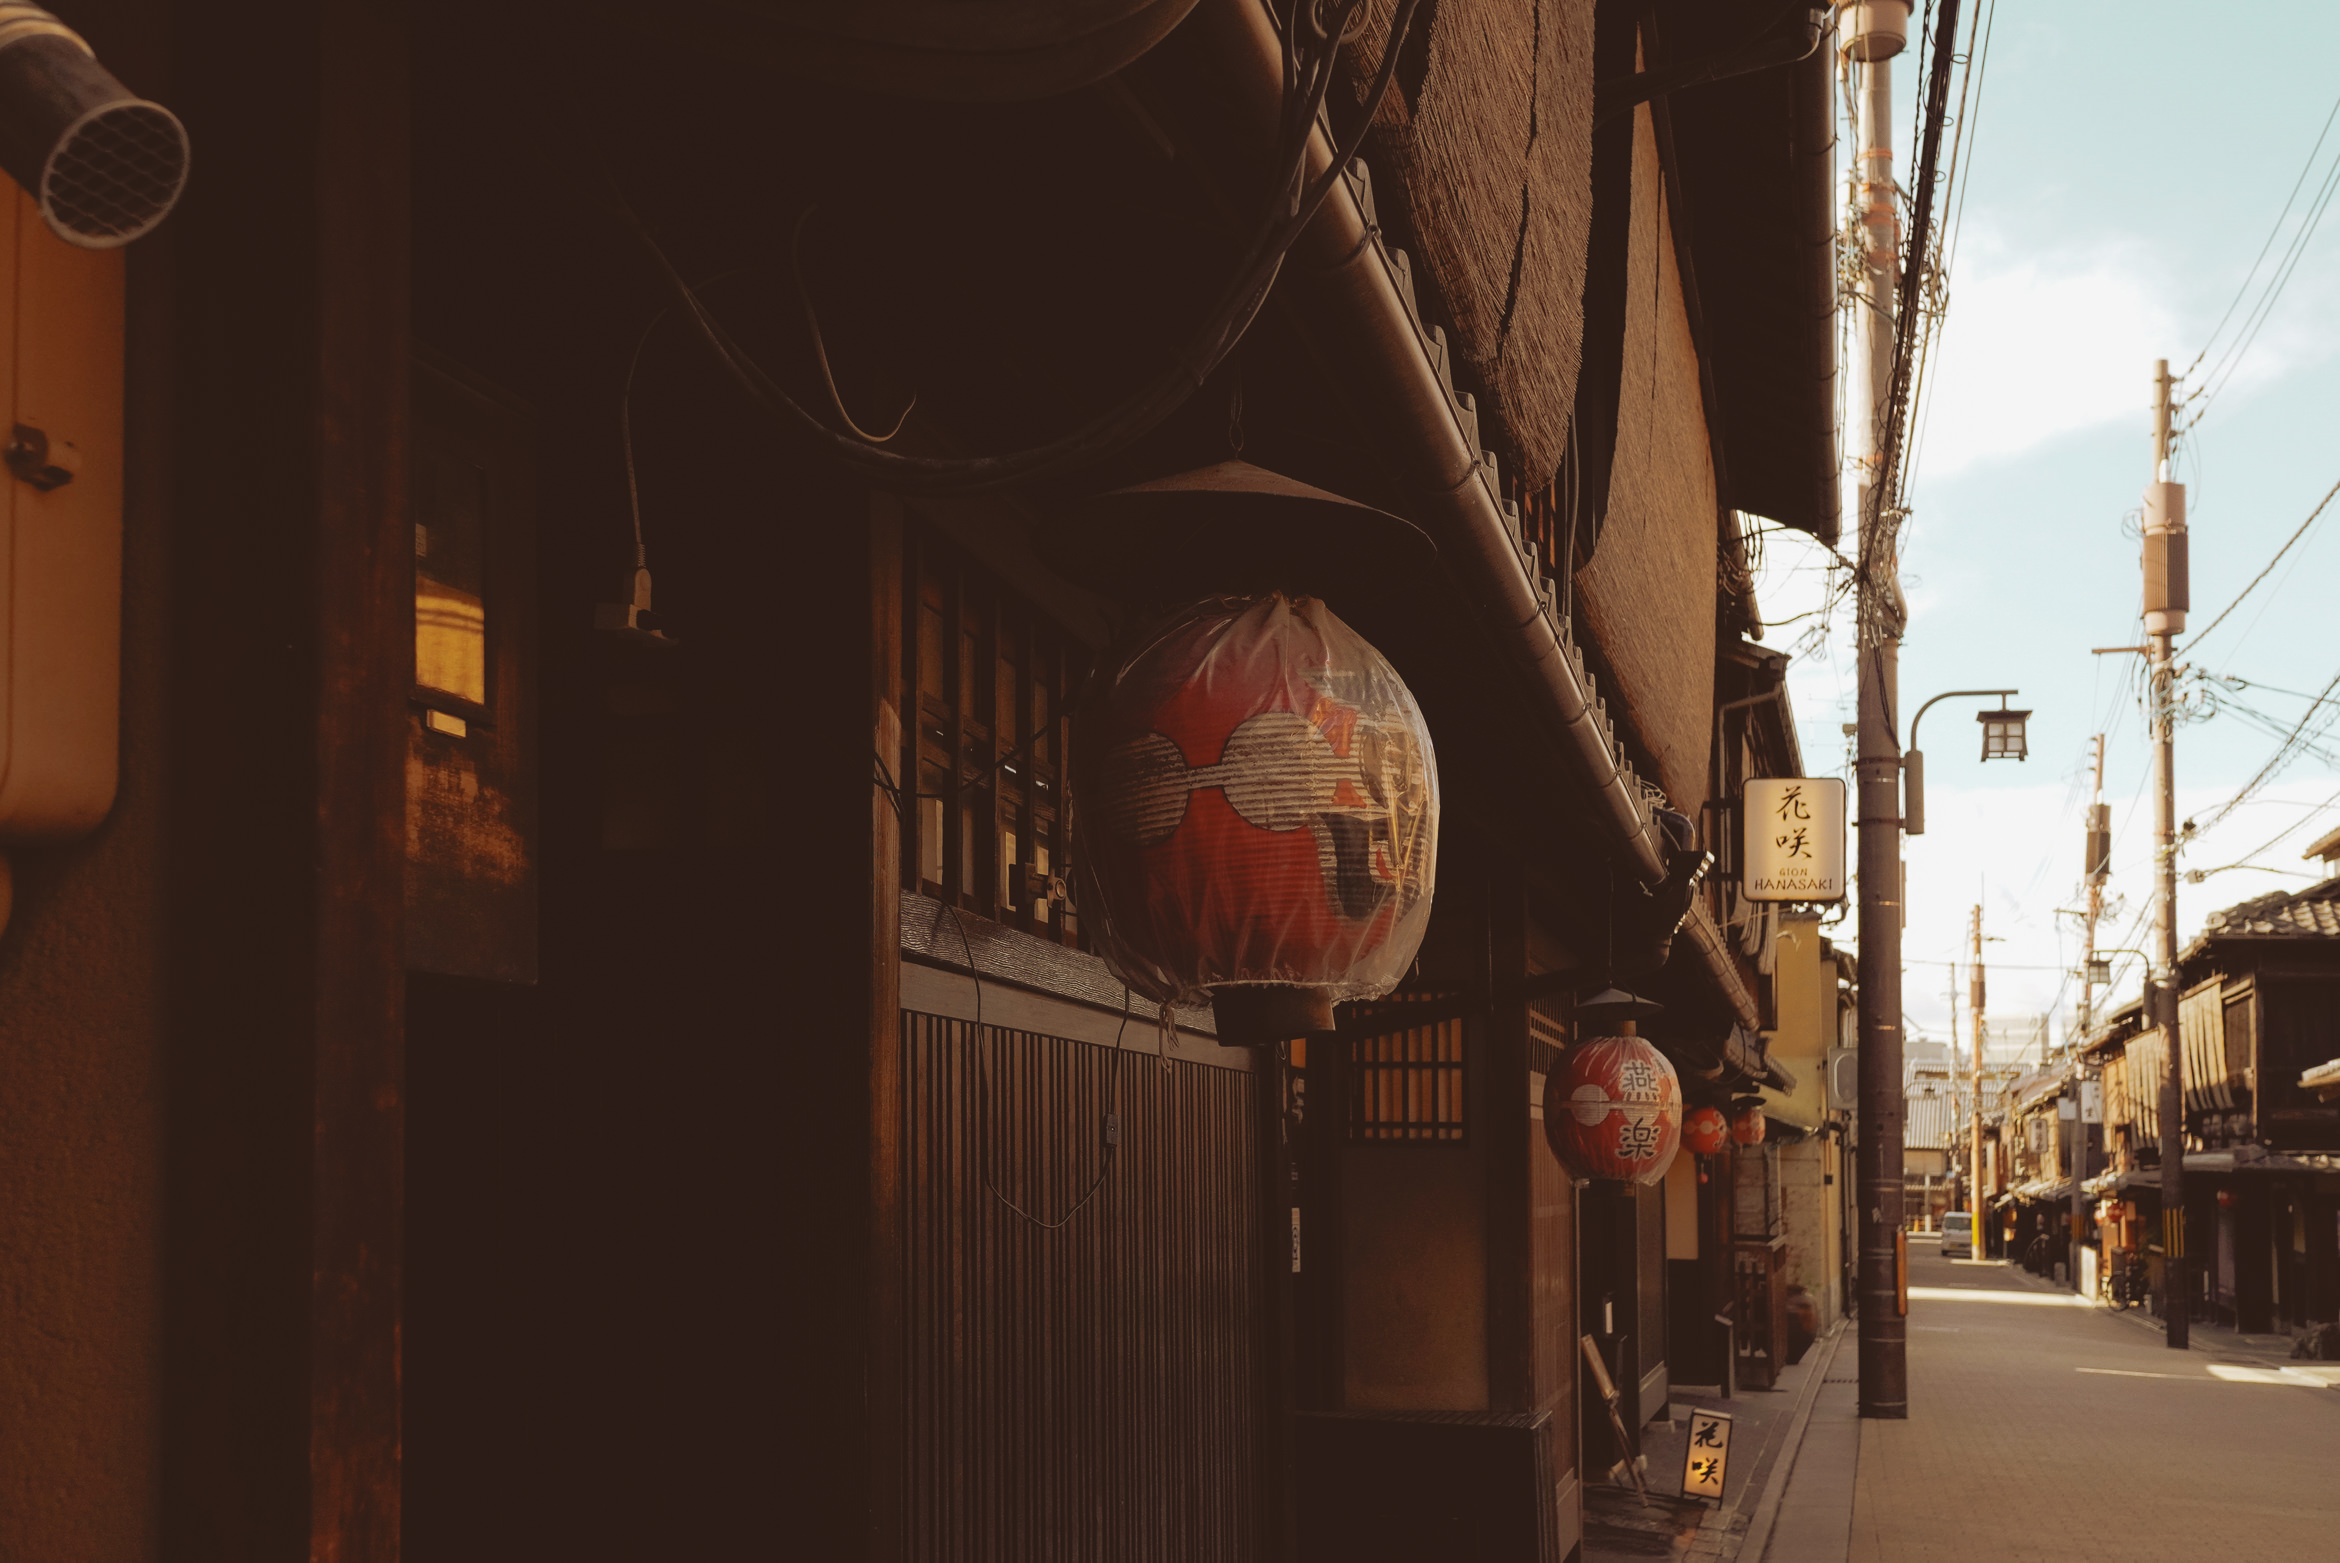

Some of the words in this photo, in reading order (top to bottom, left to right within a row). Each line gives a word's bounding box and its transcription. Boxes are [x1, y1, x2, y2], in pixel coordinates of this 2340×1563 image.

[1775, 785, 1812, 859] 花咲
[1754, 877, 1833, 891] HANASAKI
[1779, 867, 1808, 877] GION
[1619, 1060, 1660, 1160] 燕楽
[1692, 1421, 1724, 1486] 花咲
